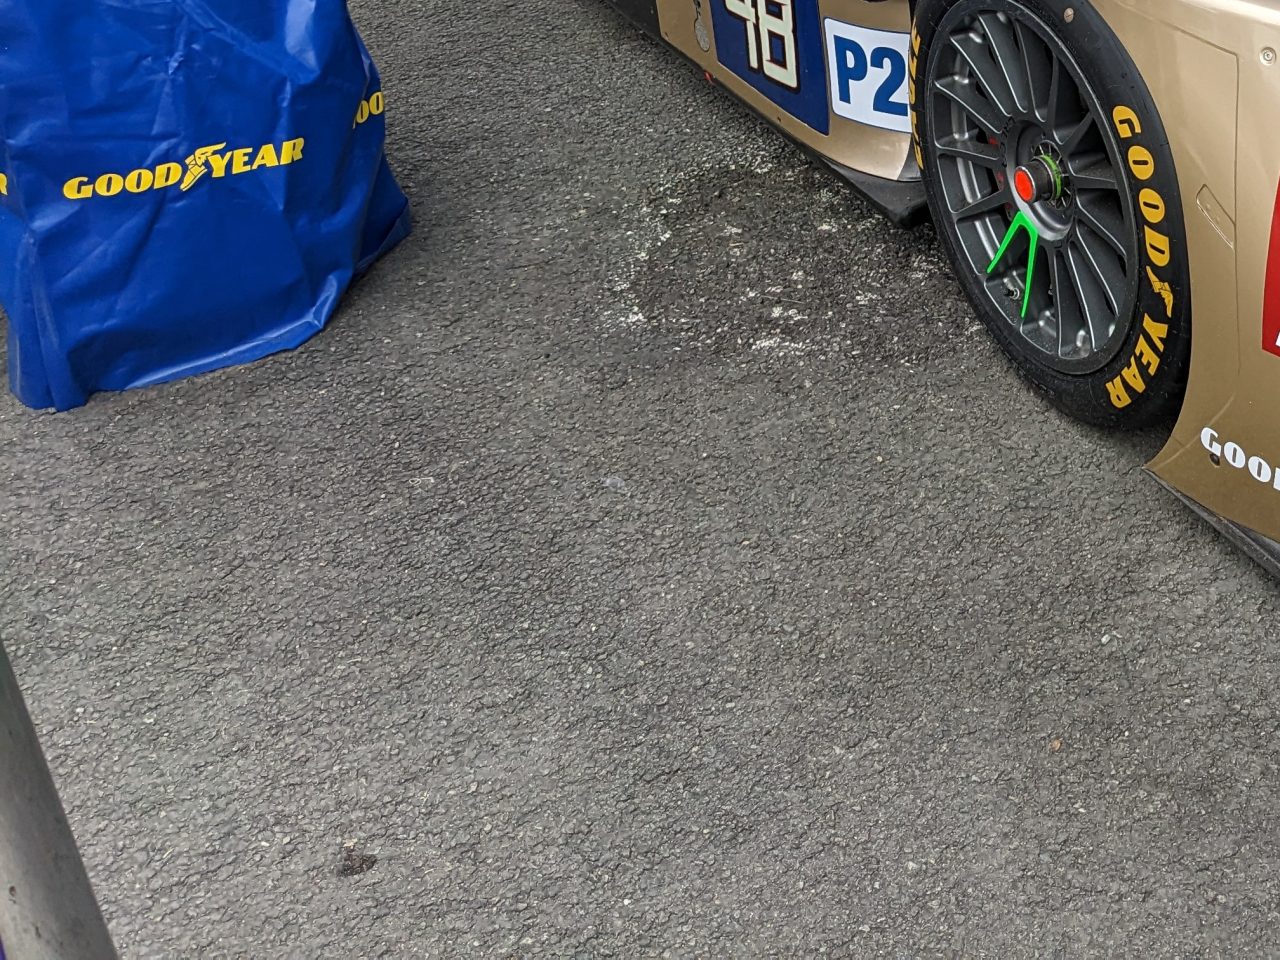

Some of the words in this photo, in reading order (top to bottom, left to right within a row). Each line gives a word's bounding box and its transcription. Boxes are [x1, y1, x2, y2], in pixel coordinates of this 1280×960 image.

[833, 34, 908, 116] P2
[62, 137, 305, 200] GOODYEAR
[1105, 105, 1174, 409] GOODYEAR
